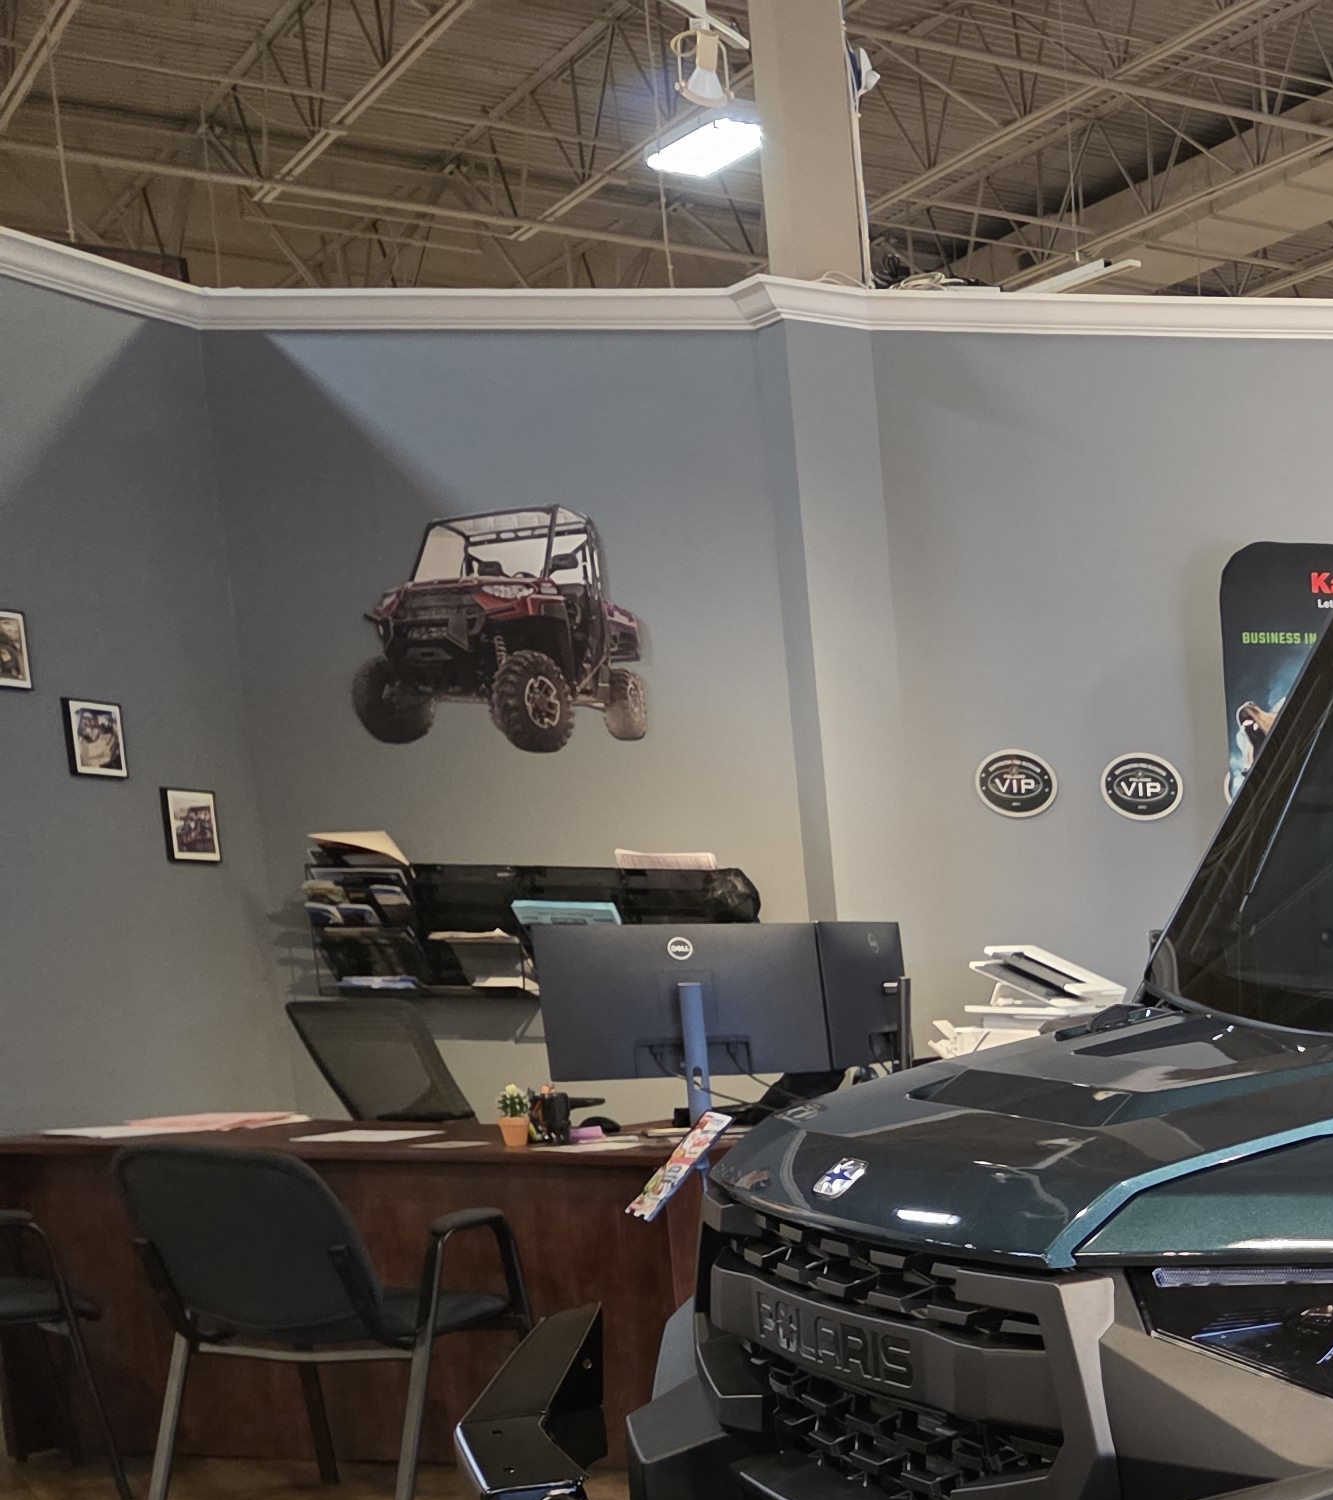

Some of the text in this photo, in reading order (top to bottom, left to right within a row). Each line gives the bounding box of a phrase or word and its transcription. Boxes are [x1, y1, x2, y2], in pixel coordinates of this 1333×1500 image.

[1241, 631, 1317, 645] BUSINESS IN
[994, 777, 1036, 794] VIP
[1120, 780, 1161, 797] VIP
[756, 1291, 914, 1389] POLARIS
